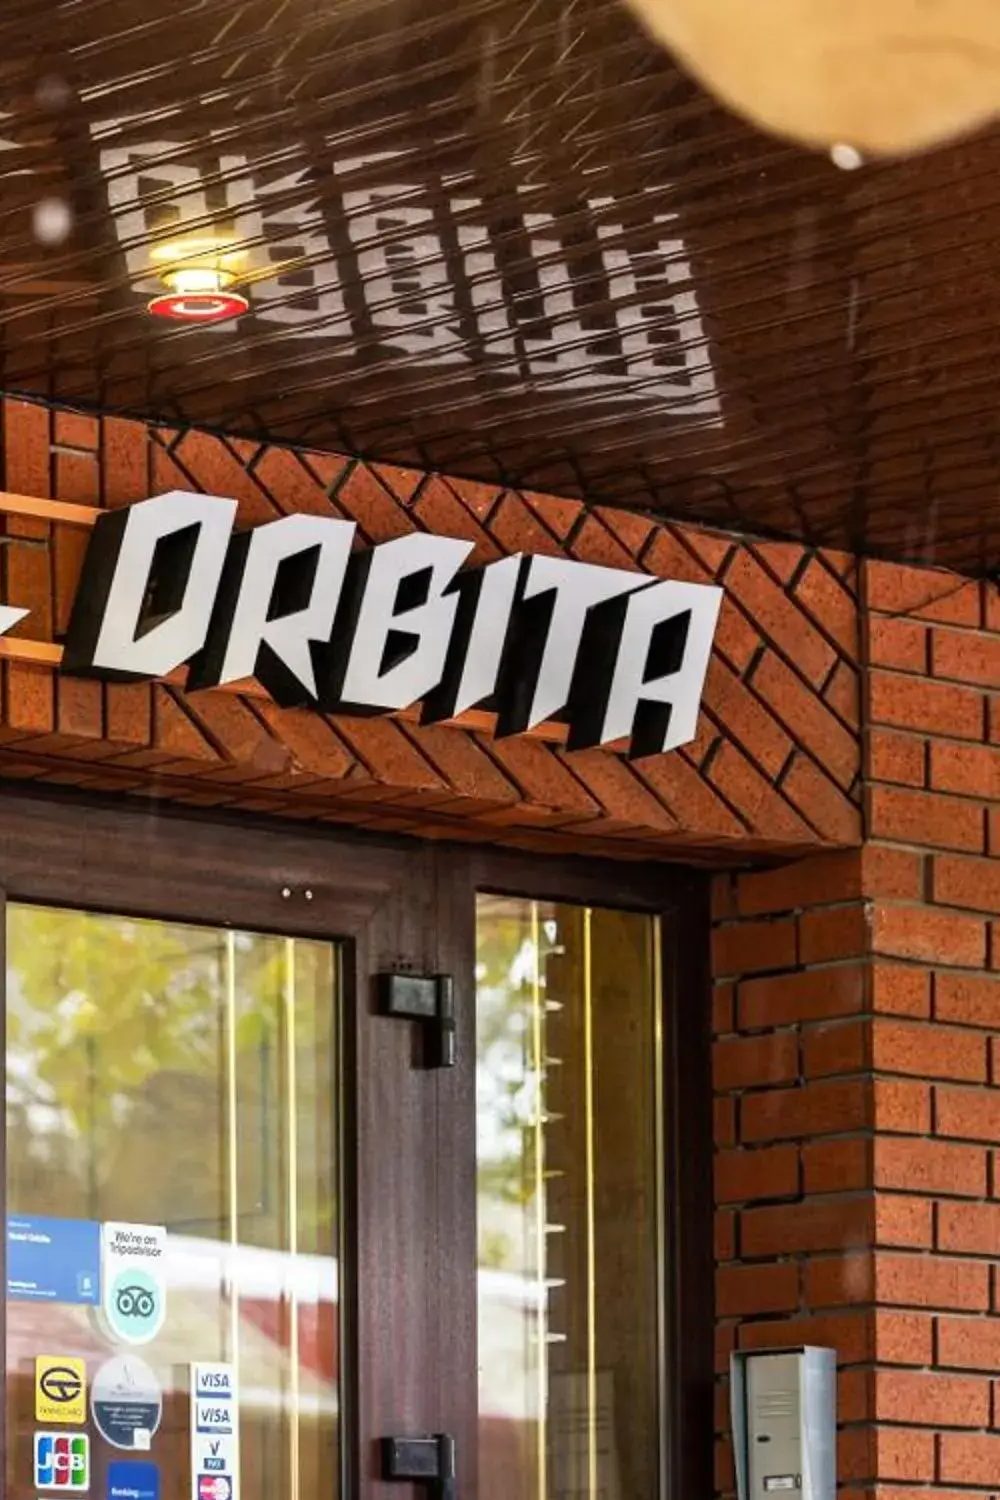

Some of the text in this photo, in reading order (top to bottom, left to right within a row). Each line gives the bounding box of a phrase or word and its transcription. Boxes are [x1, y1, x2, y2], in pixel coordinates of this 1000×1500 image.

[92, 489, 725, 754] ORBITA
[201, 1373, 231, 1388] VISA
[201, 1407, 231, 1423] VISA
[37, 1451, 86, 1471] JCB
